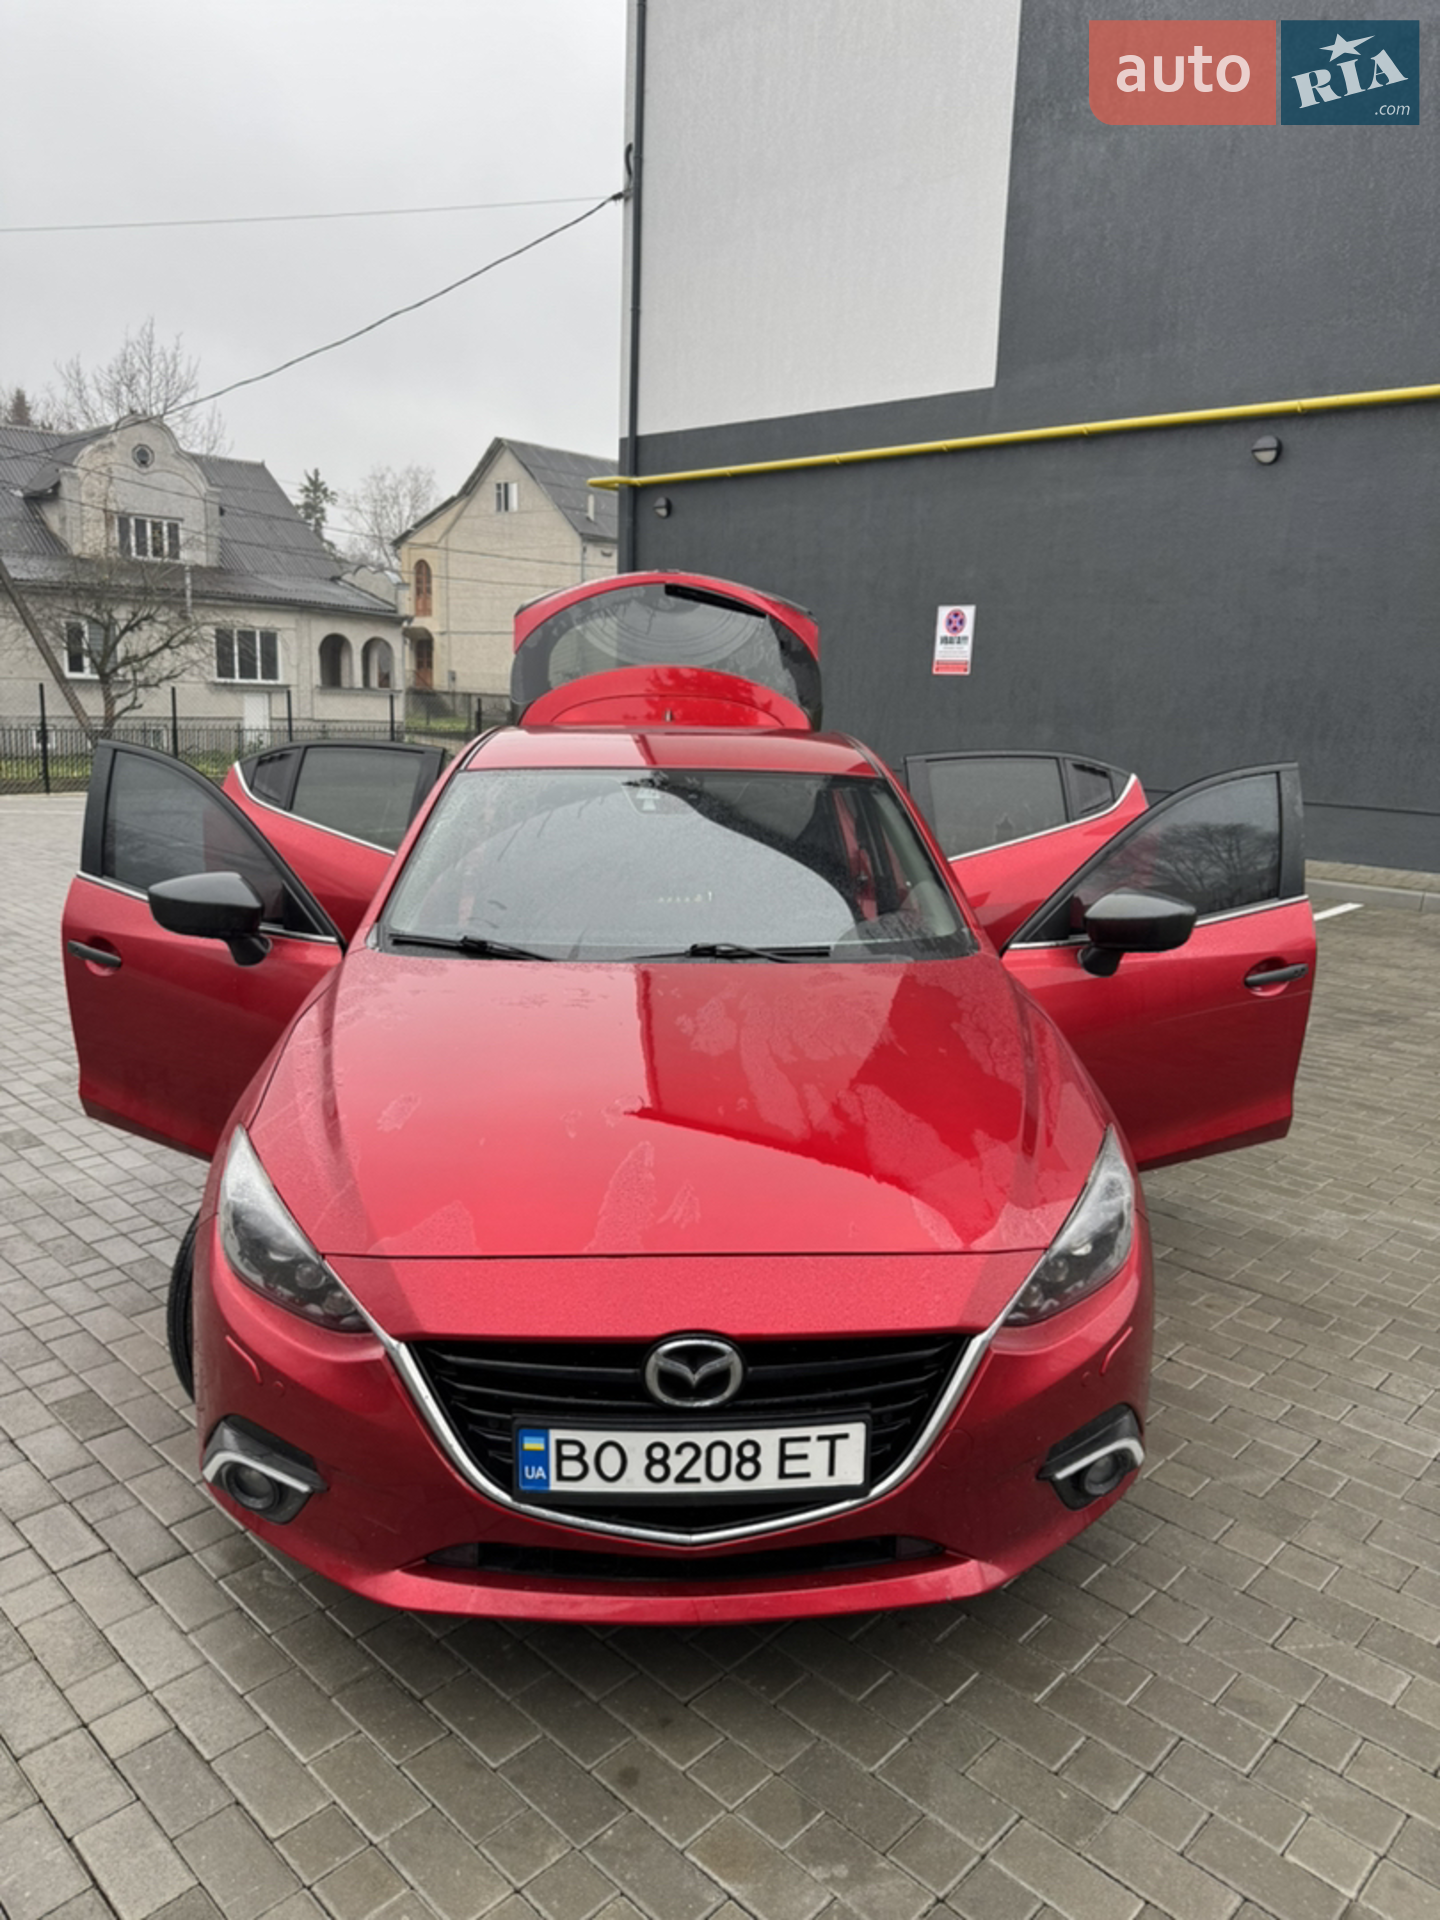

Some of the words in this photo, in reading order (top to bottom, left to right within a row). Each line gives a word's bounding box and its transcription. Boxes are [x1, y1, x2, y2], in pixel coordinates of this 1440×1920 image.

[524, 1466, 547, 1480] UA
[555, 1439, 628, 1483] BO
[644, 1439, 762, 1484] 8208
[778, 1433, 850, 1480] ET
